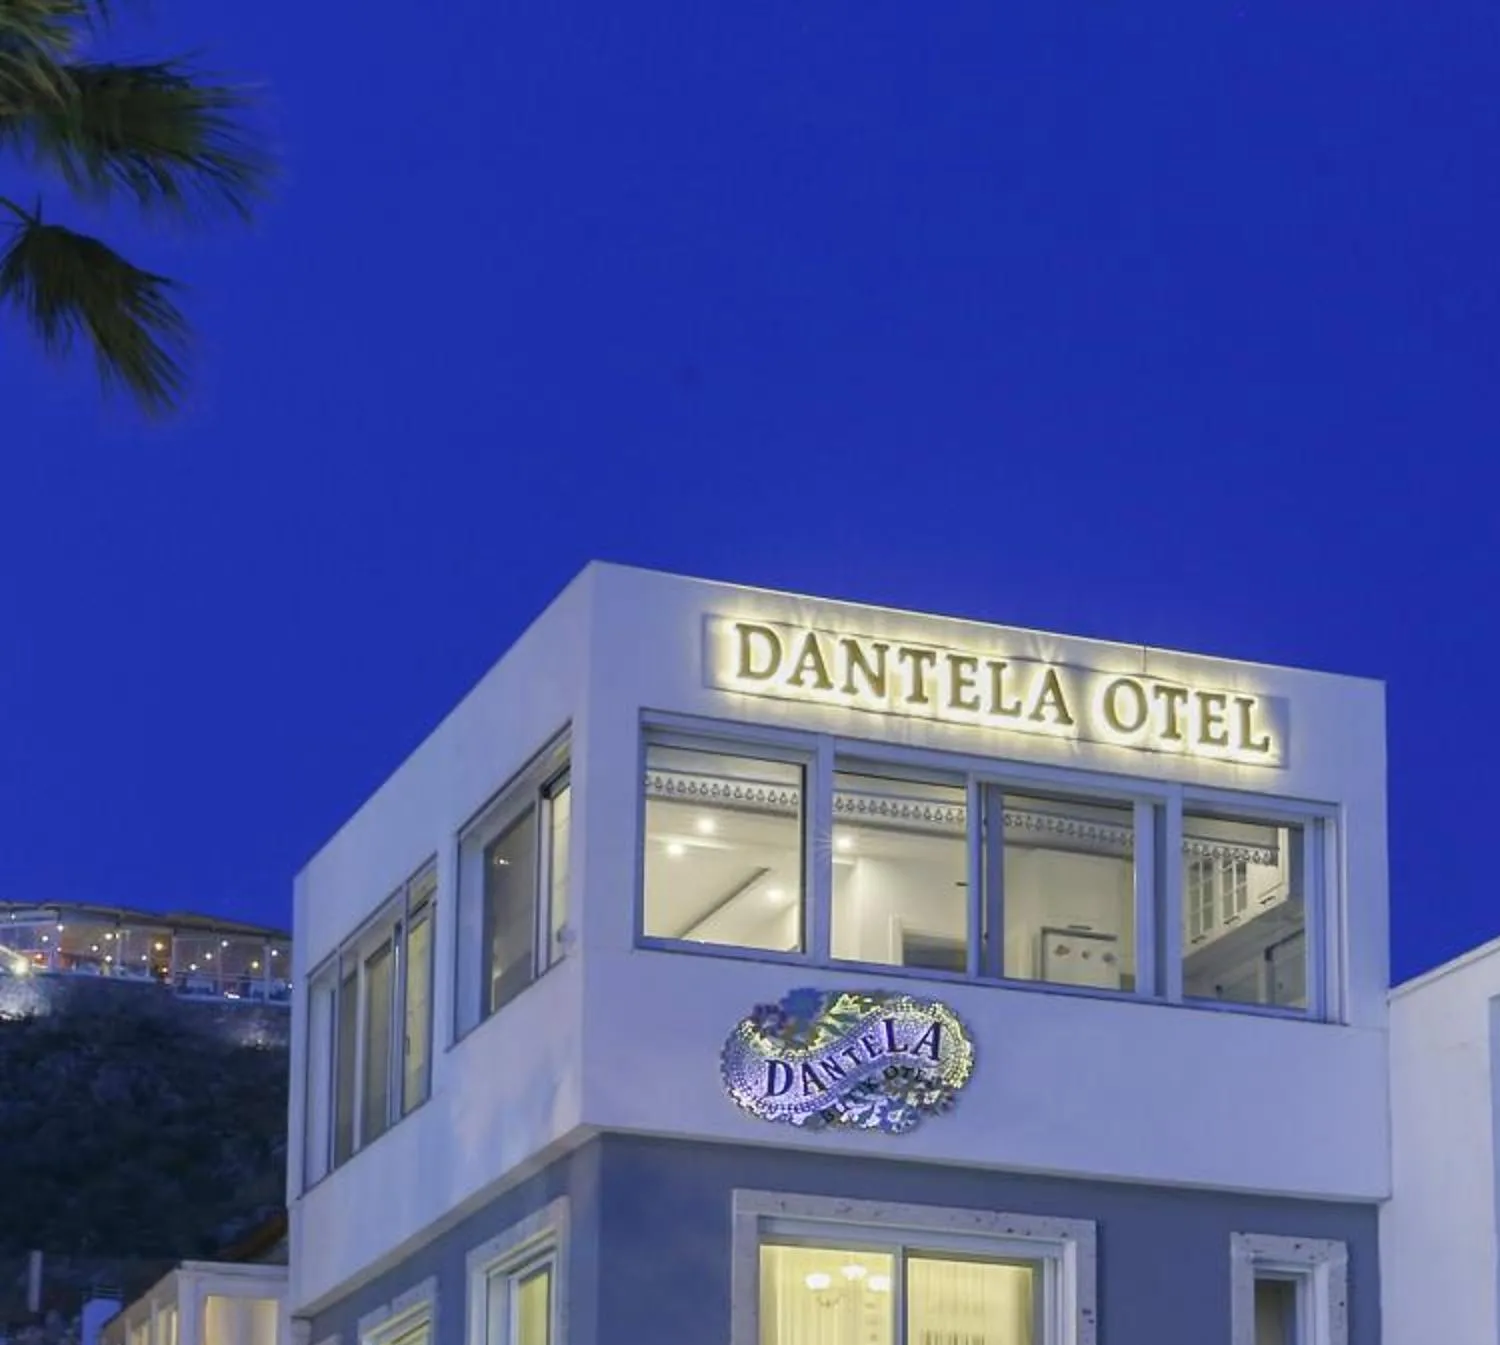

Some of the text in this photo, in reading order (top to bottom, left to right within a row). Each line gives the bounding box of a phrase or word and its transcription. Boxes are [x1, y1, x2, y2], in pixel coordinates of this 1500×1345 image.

[735, 621, 1271, 753] DANTELA OTEL
[764, 1017, 942, 1098] DANTELA
